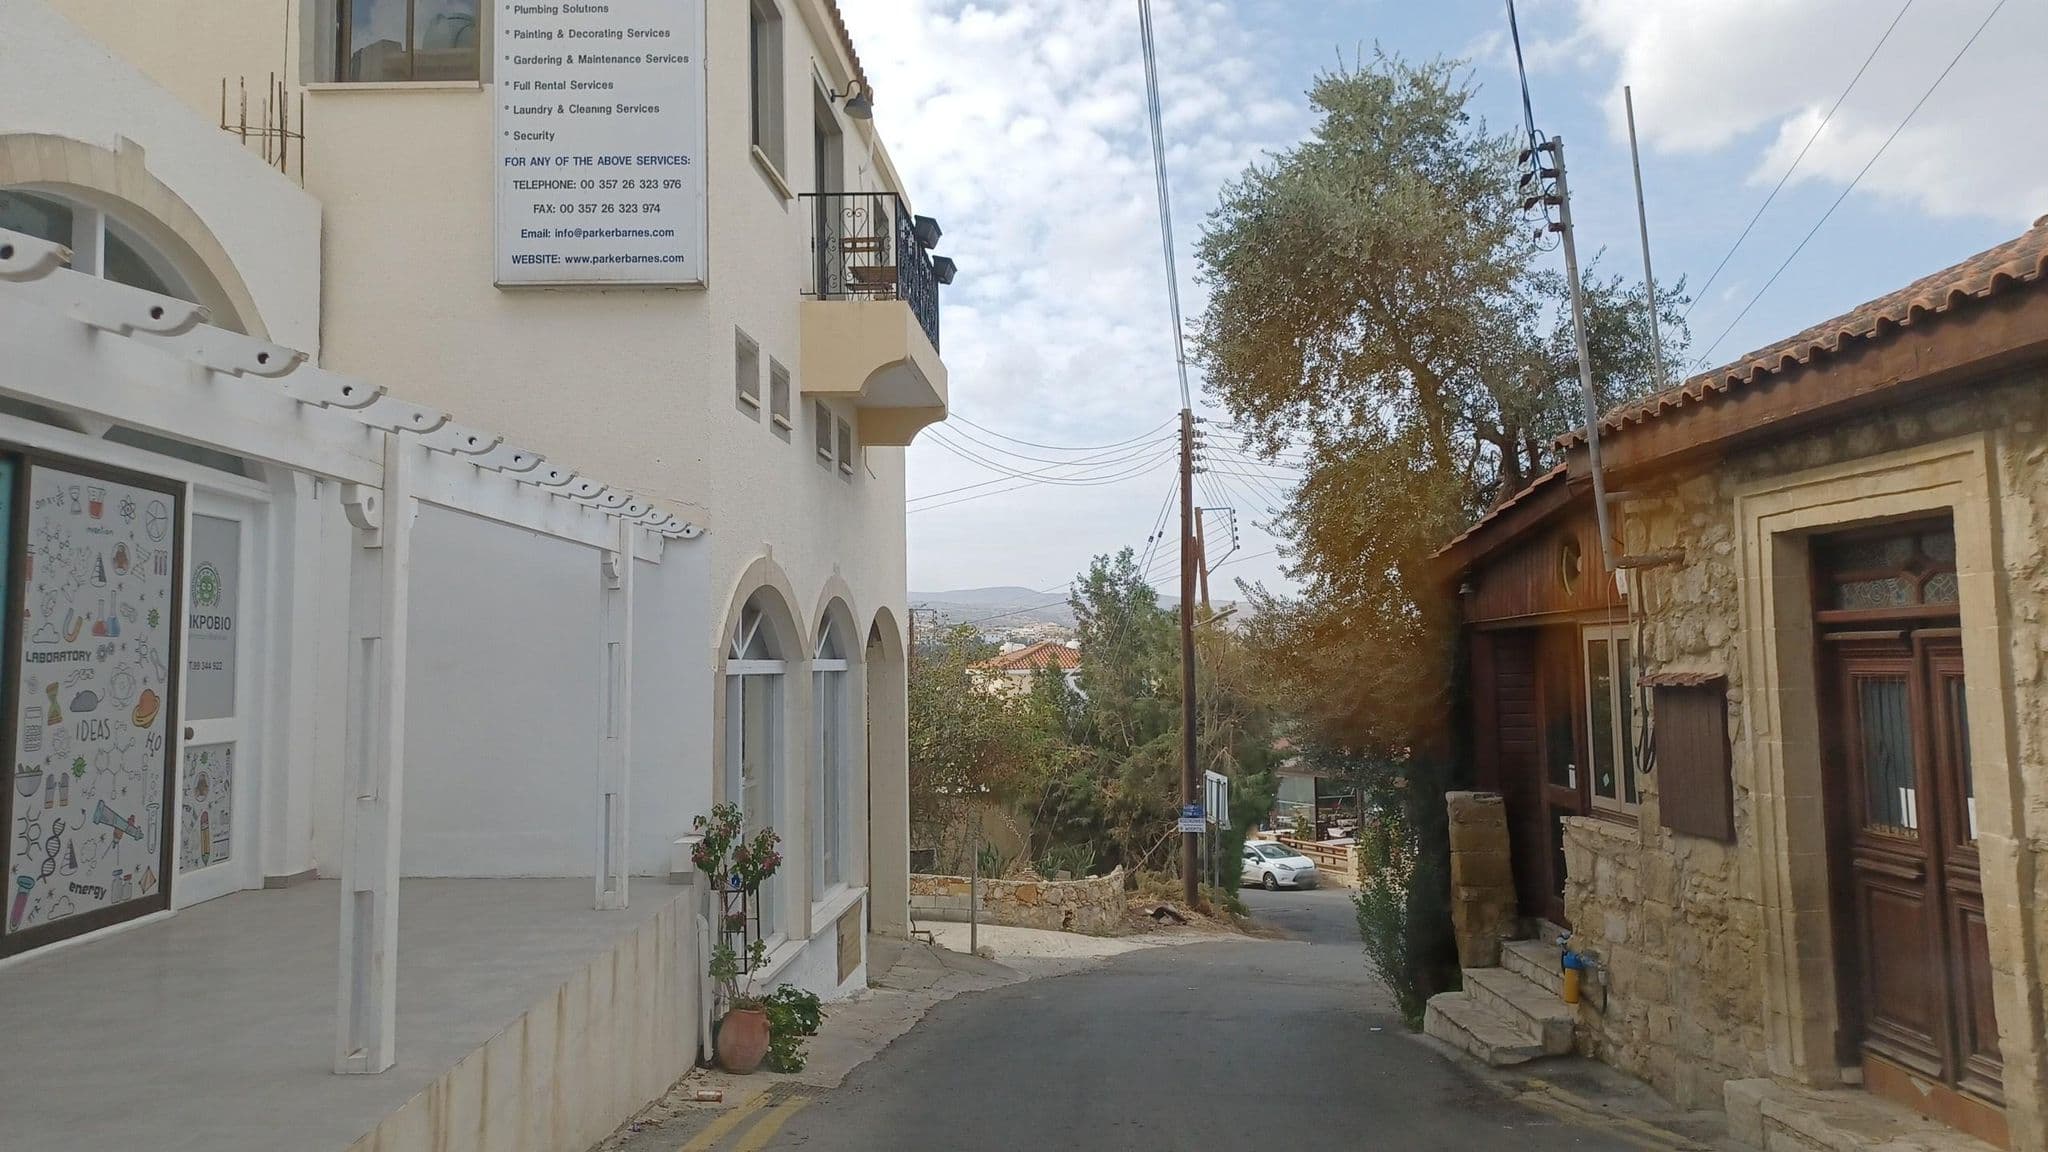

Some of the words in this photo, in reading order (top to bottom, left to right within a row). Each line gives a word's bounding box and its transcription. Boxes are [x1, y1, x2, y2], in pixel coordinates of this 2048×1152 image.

[514, 5, 558, 15] Plumbing
[563, 4, 609, 14] Solutions
[514, 30, 553, 40] Painting
[557, 30, 564, 38] &
[569, 29, 623, 39] Decorating
[627, 28, 670, 38] Services
[566, 55, 573, 64] &
[578, 54, 641, 64] Maintenance
[646, 54, 689, 63] Services
[513, 81, 530, 90] Full
[535, 81, 566, 90] Rental
[570, 80, 613, 90] Services
[513, 105, 552, 115] Laundry
[557, 105, 564, 114] &
[569, 105, 612, 115] Cleaning
[616, 104, 659, 113] Services
[513, 131, 555, 142] Security
[505, 157, 526, 166] FOR
[530, 157, 551, 166] ANY
[555, 157, 569, 166] OF
[573, 157, 593, 166] THE
[598, 156, 632, 165] ABOVE
[637, 156, 690, 165] SERVICES:
[513, 180, 576, 190] TELEPHONE:
[581, 180, 594, 189] 00
[599, 180, 618, 189] 357
[622, 180, 635, 189] 26
[640, 179, 658, 188] 323
[663, 179, 681, 188] 976
[534, 204, 555, 214] FAX:
[560, 204, 574, 214] 00
[578, 204, 597, 213] 357
[601, 204, 614, 213] 26
[619, 204, 637, 213] 323
[642, 204, 660, 213] 974
[521, 229, 551, 239] Email:
[555, 228, 674, 239] info@parkerbarnes.com
[512, 255, 560, 264] WEBSITE:
[565, 254, 684, 265] www.parkerbarnes.com
[26, 651, 91, 663] LABORATORY
[76, 718, 110, 741] IDEAS
[69, 881, 107, 900] energy
